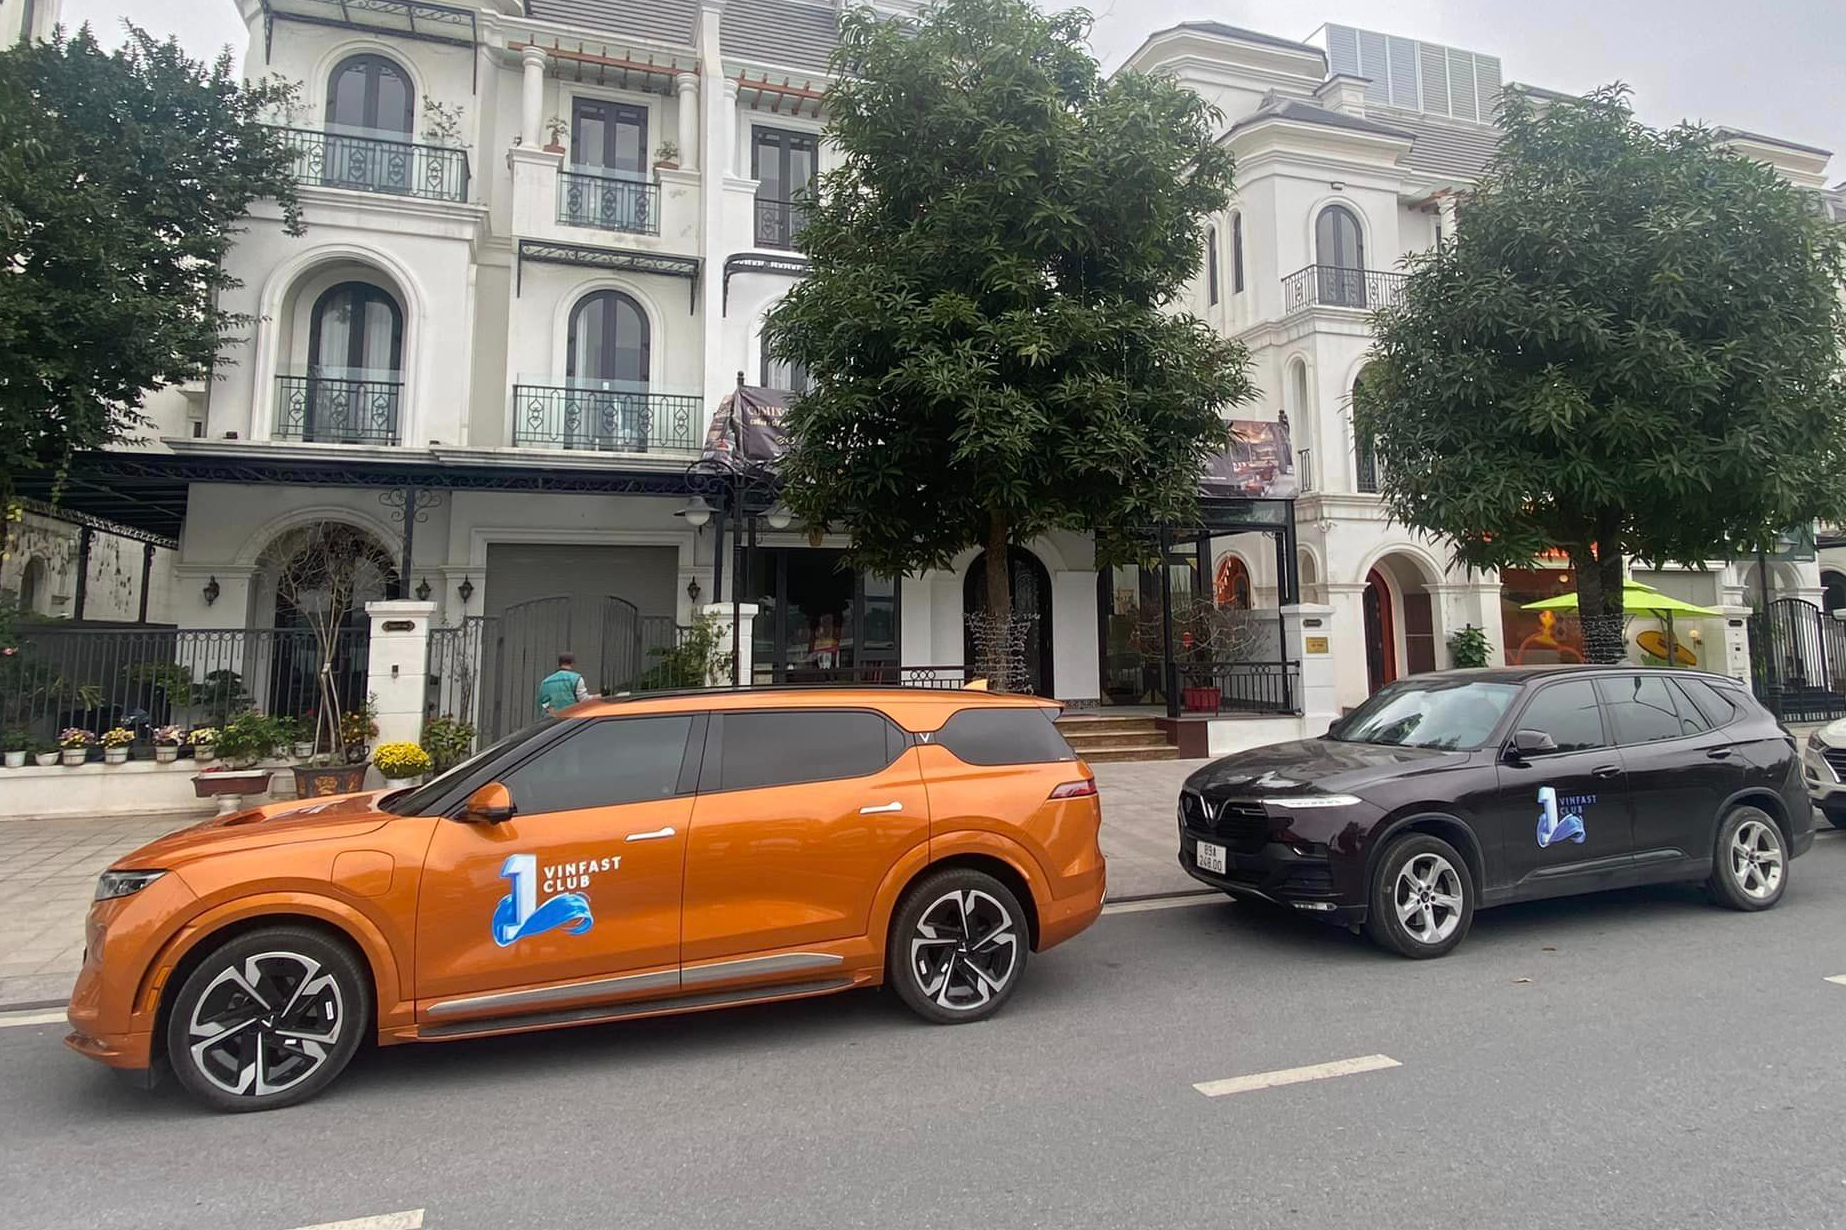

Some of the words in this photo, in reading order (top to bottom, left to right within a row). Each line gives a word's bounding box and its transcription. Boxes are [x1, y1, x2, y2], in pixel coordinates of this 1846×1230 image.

[1559, 795, 1597, 806] VINFAST
[1560, 806, 1583, 815] CLUB
[543, 856, 622, 879] VINFAST
[543, 875, 590, 893] CLUB
